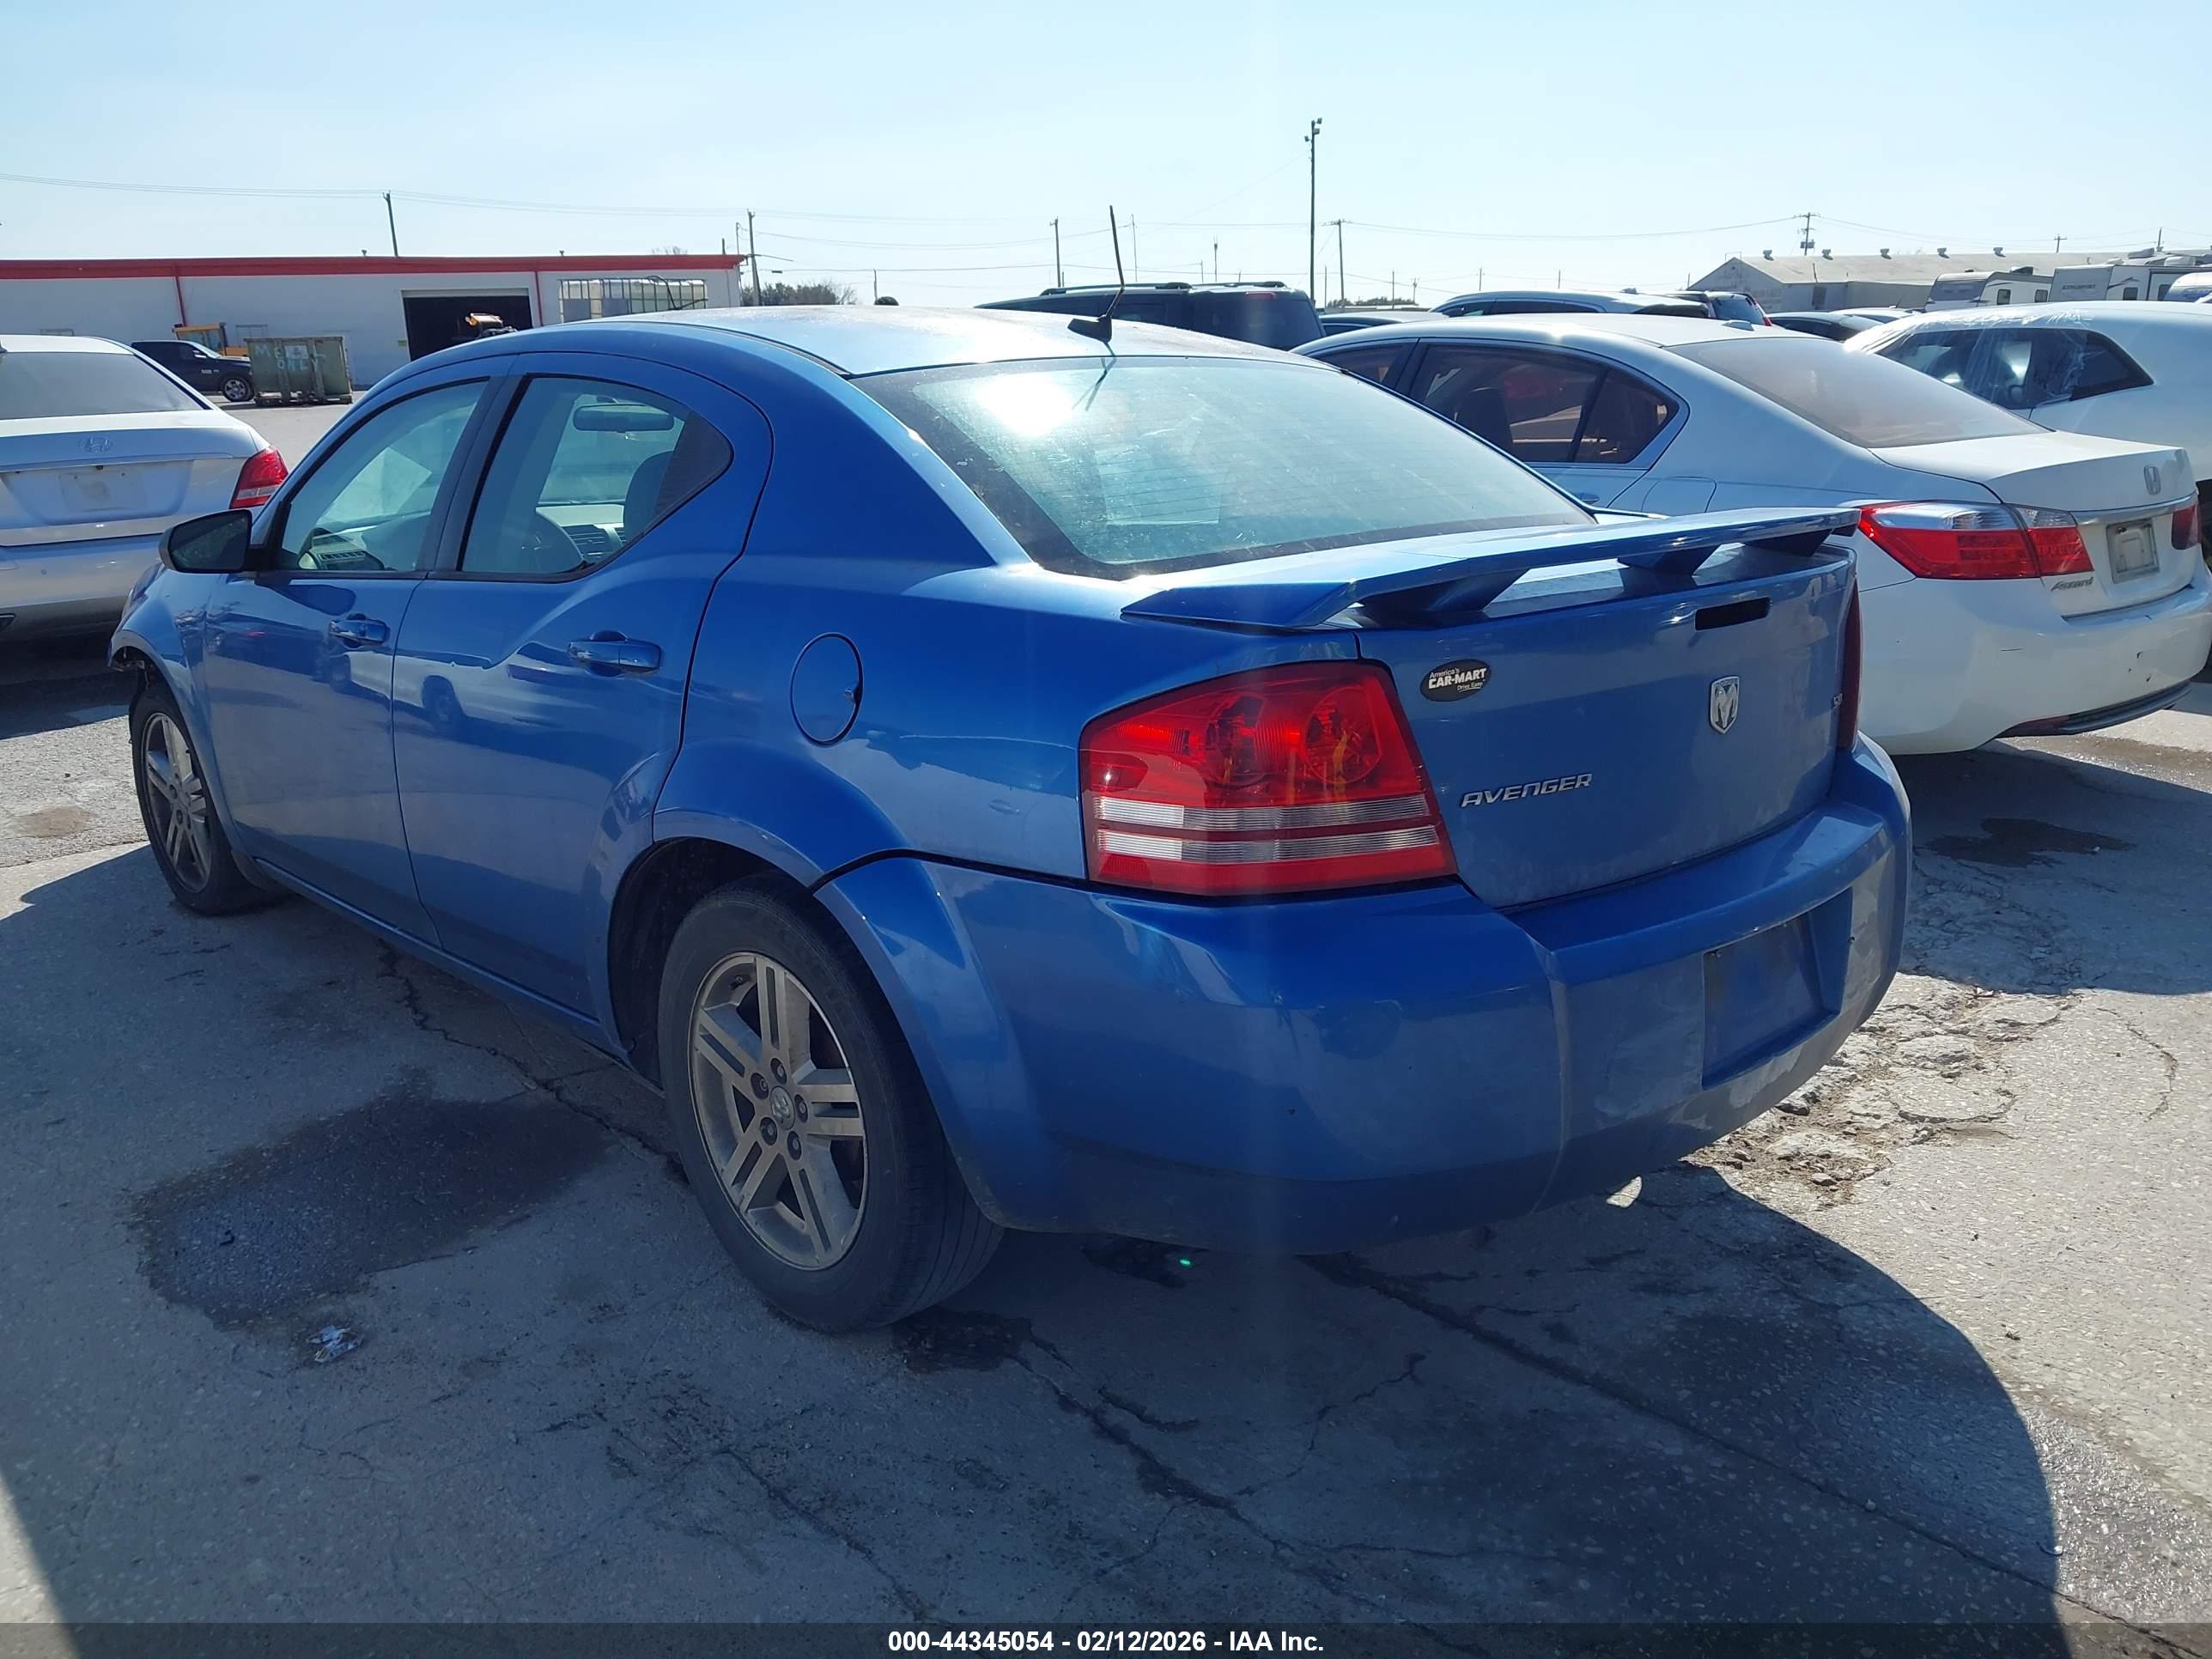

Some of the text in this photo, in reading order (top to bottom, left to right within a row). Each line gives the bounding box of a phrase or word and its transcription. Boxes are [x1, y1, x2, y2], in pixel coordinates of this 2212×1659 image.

[1428, 668, 1487, 690] CAR-MART
[1429, 667, 1460, 678] America's
[1461, 773, 1593, 808] AVENGER
